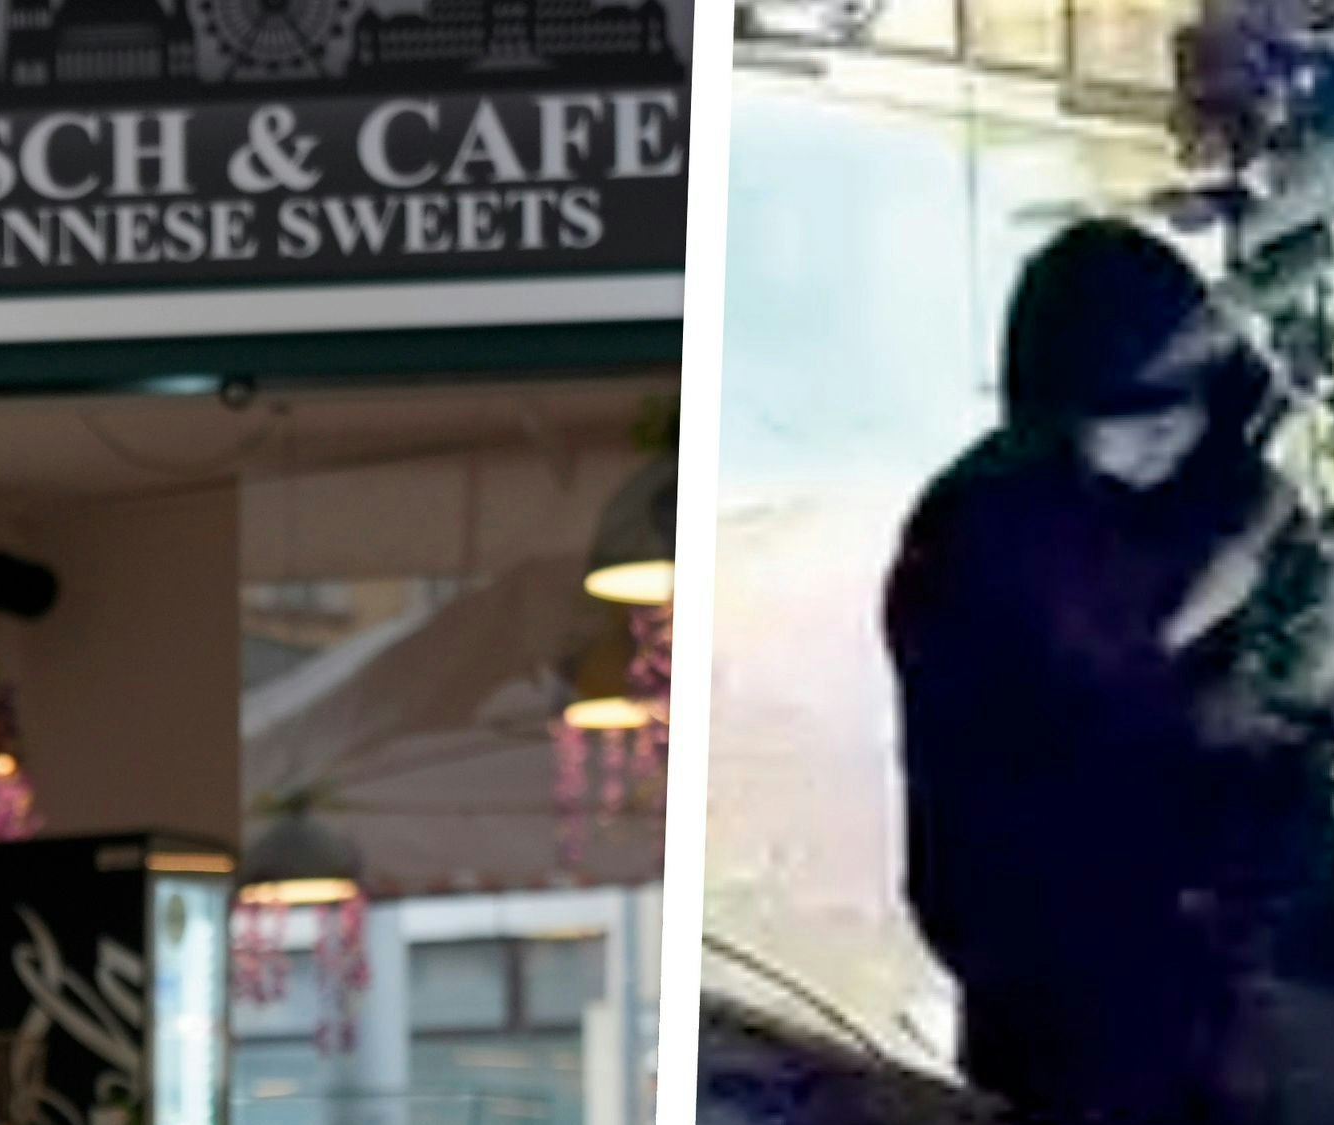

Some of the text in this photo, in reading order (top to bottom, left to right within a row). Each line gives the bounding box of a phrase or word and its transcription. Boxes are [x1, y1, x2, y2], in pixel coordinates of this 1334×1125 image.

[226, 101, 323, 195] &
[356, 91, 684, 190] CAFE
[277, 186, 605, 258] SWEETS
